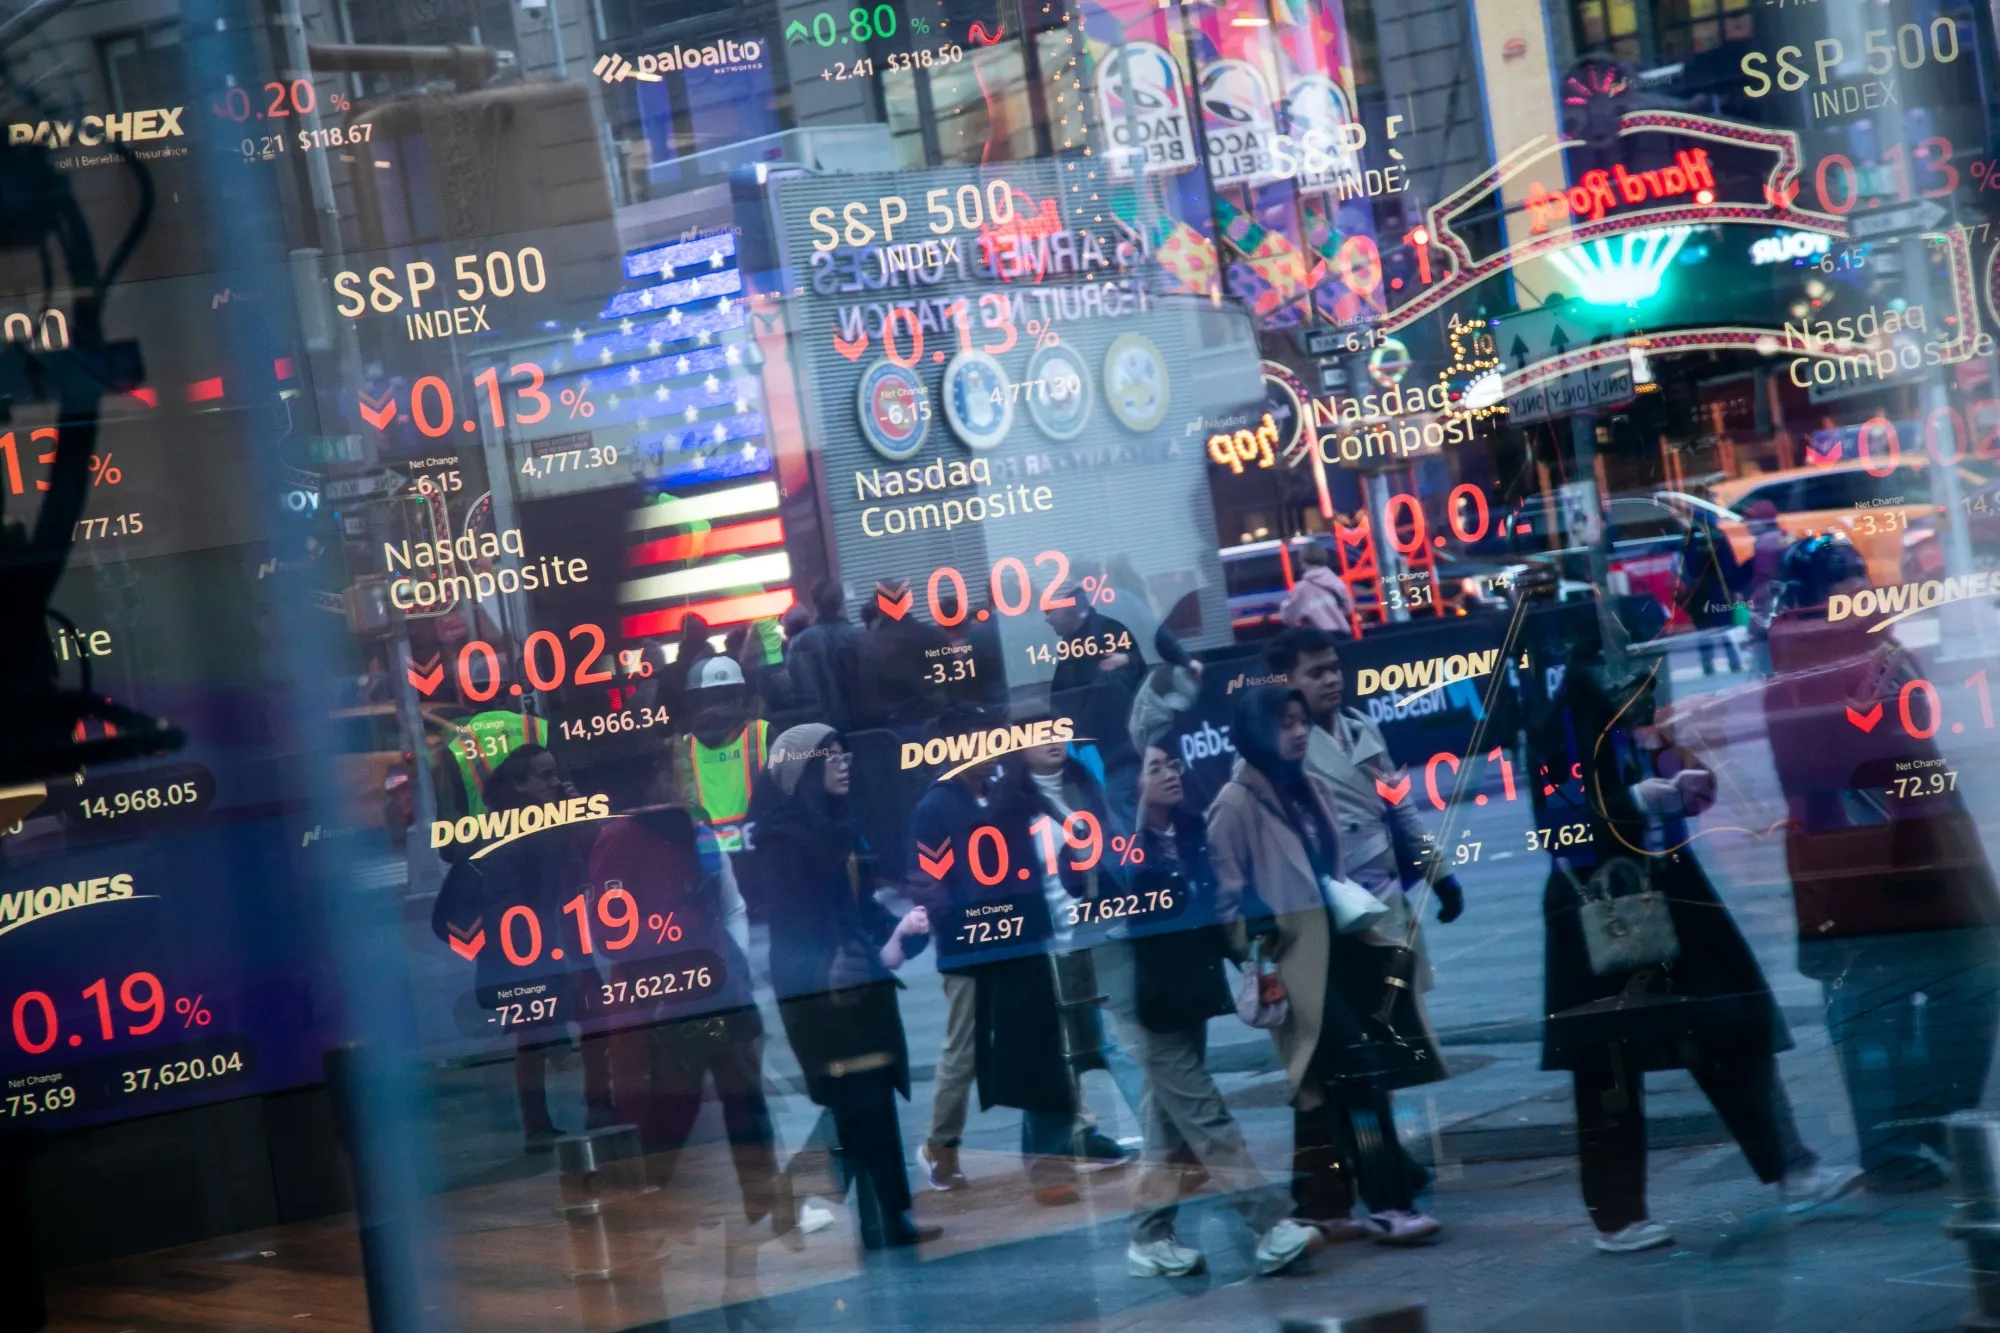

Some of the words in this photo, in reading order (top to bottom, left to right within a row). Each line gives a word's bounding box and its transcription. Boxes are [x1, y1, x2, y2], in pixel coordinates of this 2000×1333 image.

[813, 4, 897, 47] 0.80
[637, 38, 760, 75] paloalto
[820, 58, 874, 82] +2.41
[887, 45, 963, 73] $318.50
[1741, 38, 1843, 98] S&P
[1865, 17, 1959, 76] 500
[226, 78, 316, 122] 0.20
[1813, 79, 1898, 119] INDEX
[8, 107, 184, 149] PAYCHEX
[298, 123, 372, 151] $118.67
[1269, 122, 1367, 180] S&P
[810, 195, 908, 252] S&P
[927, 179, 1014, 235] 500
[879, 236, 961, 275] INDEX
[1810, 248, 1865, 274] -6.15
[334, 262, 436, 318] S&P
[455, 246, 547, 302] 500
[406, 304, 490, 341] INDEX
[1784, 304, 1927, 351] Nasdaq
[1337, 328, 1389, 353] -6.15
[1790, 331, 1993, 388] Composite
[880, 389, 896, 399] Net
[879, 400, 932, 425] -6.15
[409, 458, 425, 470] Net
[426, 454, 459, 468] Change
[521, 444, 618, 479] 4,777.30
[408, 470, 463, 496] -6.15
[856, 456, 992, 501] Nasdaq
[861, 483, 1054, 538] Composite
[1855, 501, 1871, 510] Net
[1872, 495, 1905, 508] Change
[1852, 510, 1908, 536] -3.31
[384, 528, 525, 573] Nasdaq
[390, 555, 589, 610] Composite
[1398, 570, 1430, 583] Change
[1380, 585, 1433, 610] -3.31
[925, 648, 941, 659] Net
[942, 642, 973, 657] Change
[1025, 630, 1132, 666] 14,966.34
[923, 657, 977, 685] -3.31
[1246, 671, 1288, 687] Nasdaq
[456, 723, 473, 734] Net
[474, 719, 505, 733] Change
[559, 705, 670, 742] 14,966.34
[454, 733, 510, 761] -3.31
[787, 747, 829, 762] Nasdaq
[1896, 762, 1912, 772] Net
[1913, 757, 1947, 769] Change
[80, 781, 198, 820] 14,968.05
[1885, 771, 1959, 800] -72.97
[965, 908, 981, 919] Net
[982, 903, 1013, 916] Change
[1066, 888, 1174, 926] 37,622.76
[956, 916, 1025, 945] -72.97
[498, 989, 513, 1000] Net
[514, 983, 547, 998] Change
[601, 966, 712, 1004] 37,622.76
[487, 997, 558, 1028] -72.97
[8, 1078, 26, 1089] Net
[27, 1071, 63, 1087] Change
[122, 1051, 244, 1094] 37,620.04
[0, 1086, 76, 1118] -75.69
